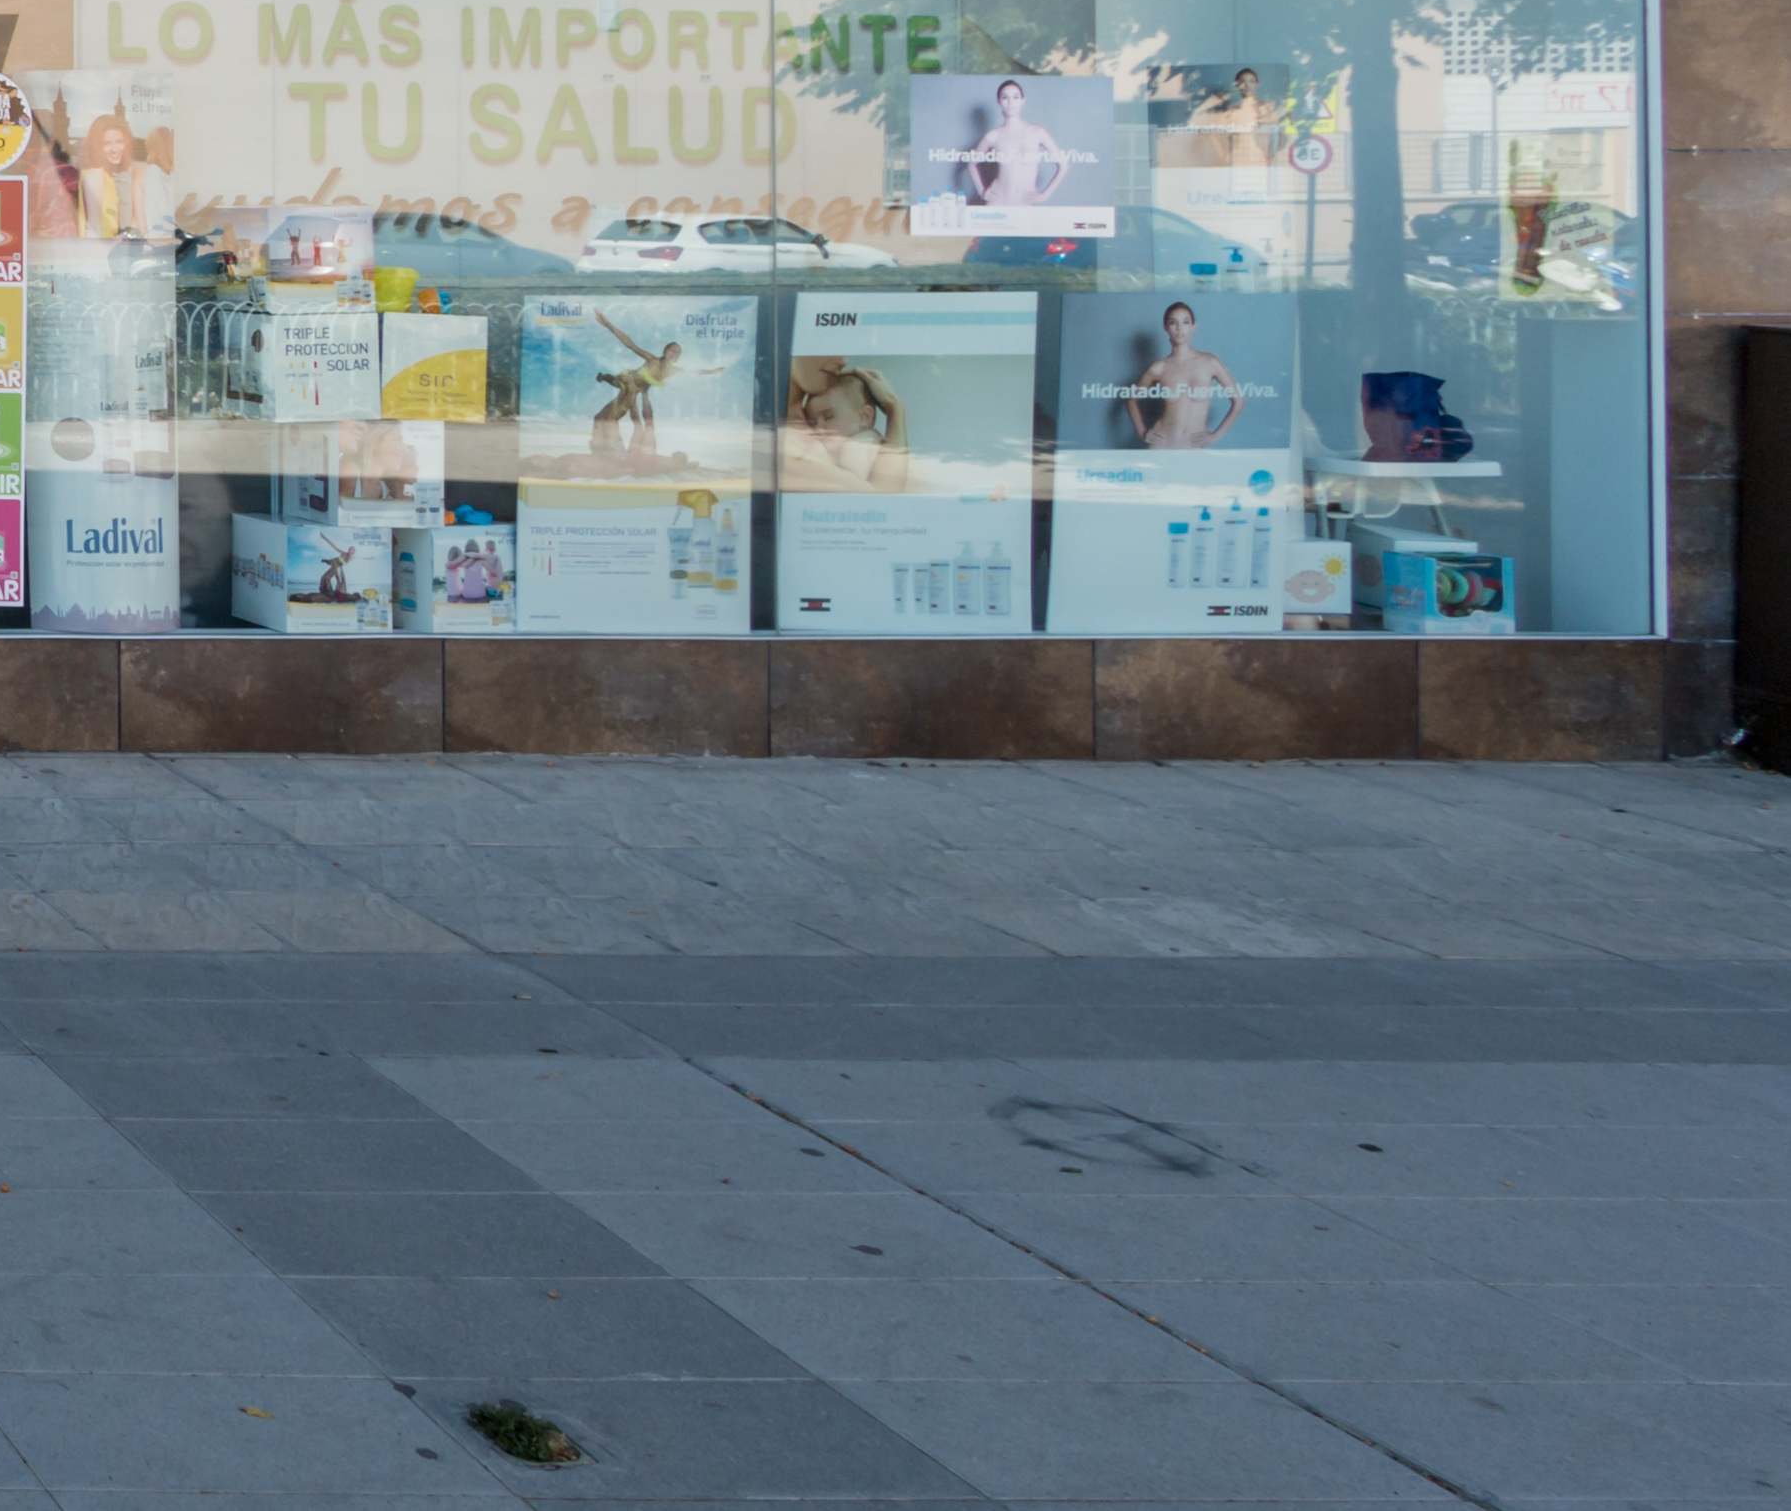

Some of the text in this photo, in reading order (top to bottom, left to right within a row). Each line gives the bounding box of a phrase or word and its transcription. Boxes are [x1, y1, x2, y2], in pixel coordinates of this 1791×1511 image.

[106, 0, 216, 63] LO
[460, 4, 942, 74] IMPORTANTE
[132, 102, 143, 112] el
[288, 80, 799, 166] TU SALUD
[685, 314, 737, 326] Disfruta
[815, 313, 857, 326] ISDIN
[284, 327, 330, 339] TRIPLE
[696, 327, 745, 340] el triple
[327, 359, 369, 372] SOLAR
[66, 517, 163, 554] Ladival
[530, 526, 657, 536] TRIPLE PROTECCIÓN SOLAR
[1234, 605, 1269, 617] ISDIN
